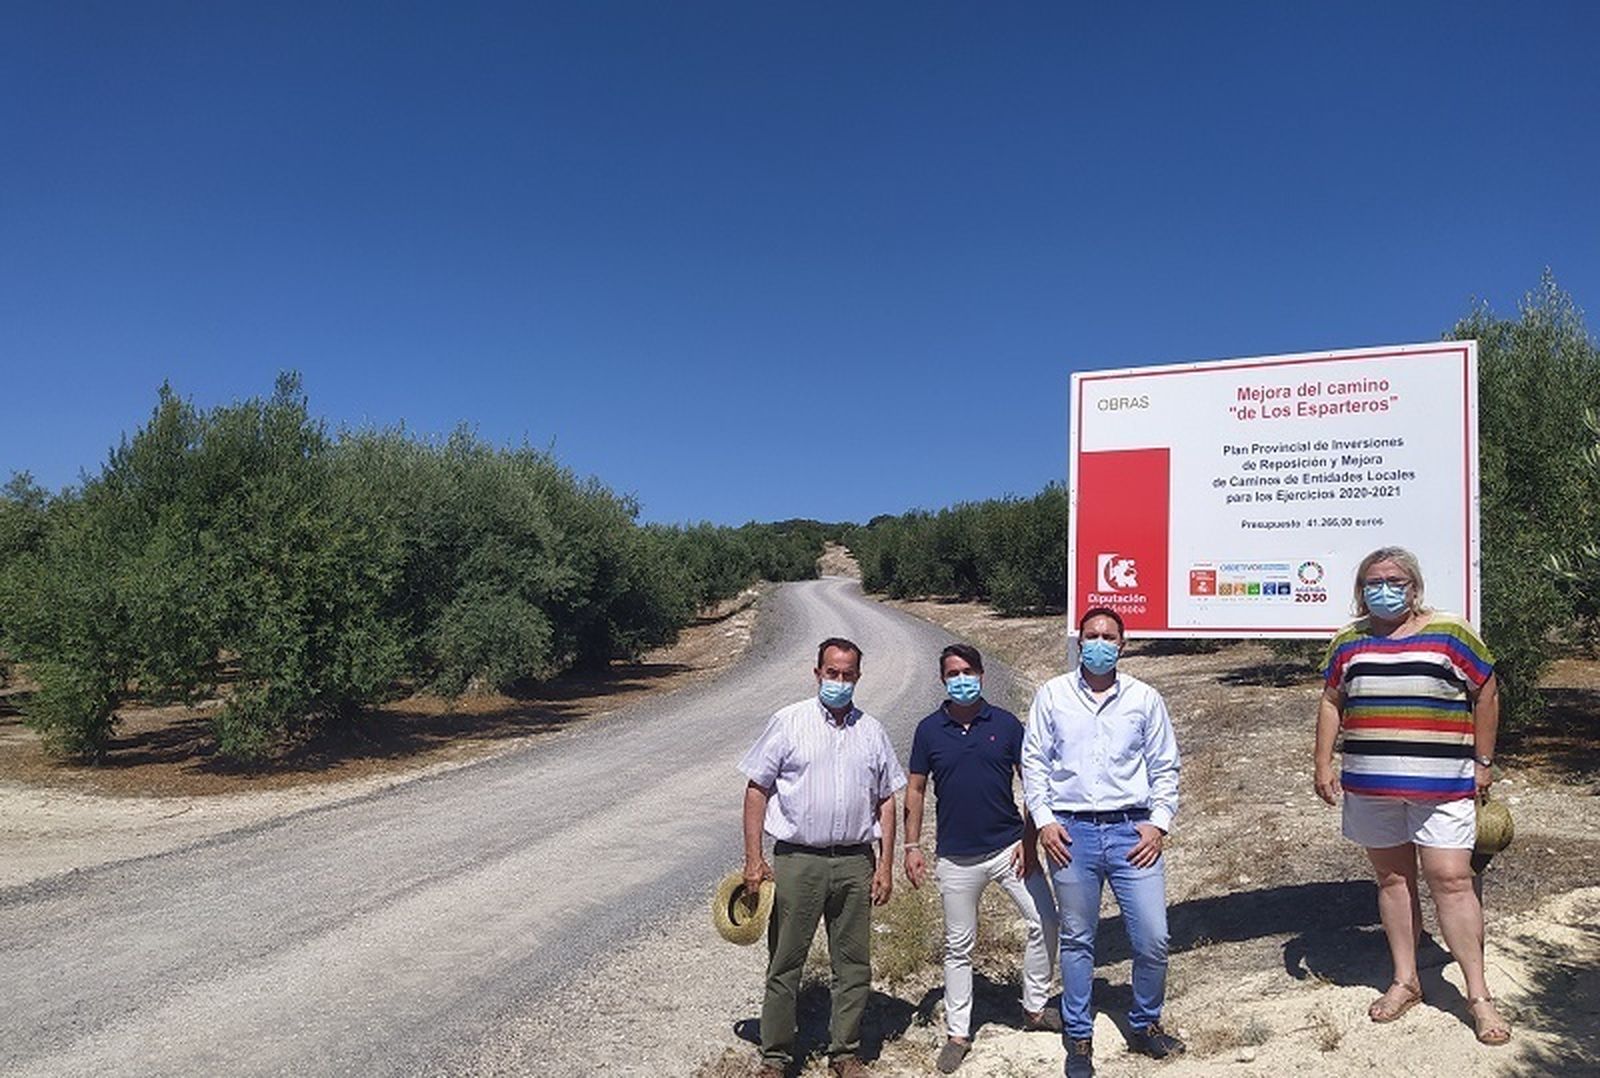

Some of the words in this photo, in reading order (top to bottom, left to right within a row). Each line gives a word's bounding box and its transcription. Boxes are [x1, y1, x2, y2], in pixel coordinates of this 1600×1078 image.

[1237, 385, 1292, 404] Mejora
[1297, 381, 1321, 398] del
[1327, 378, 1390, 395] camino
[1097, 395, 1150, 411] OBRAS
[1229, 405, 1257, 421] "de
[1262, 402, 1292, 418] Los
[1297, 395, 1399, 419] Esparteros"
[1223, 445, 1249, 455] Plan
[1251, 441, 1311, 454] Provincial
[1314, 441, 1329, 451] de
[1332, 437, 1404, 450] Inversiones
[1242, 461, 1256, 471] de
[1259, 456, 1327, 471] Reposición
[1330, 459, 1337, 468] y
[1341, 454, 1383, 467] Mejora
[1212, 478, 1227, 488] de
[1229, 475, 1281, 487] Caminos
[1284, 474, 1299, 485] de
[1302, 472, 1363, 484] Entidades
[1367, 470, 1416, 482] Locales
[1226, 494, 1252, 504] para
[1255, 491, 1273, 502] los
[1276, 489, 1335, 503] Ejercicios
[1339, 486, 1401, 499] 2020-2021
[1355, 517, 1384, 526] euros
[1088, 593, 1147, 604] Diputación
[1295, 593, 1327, 603] 2030
